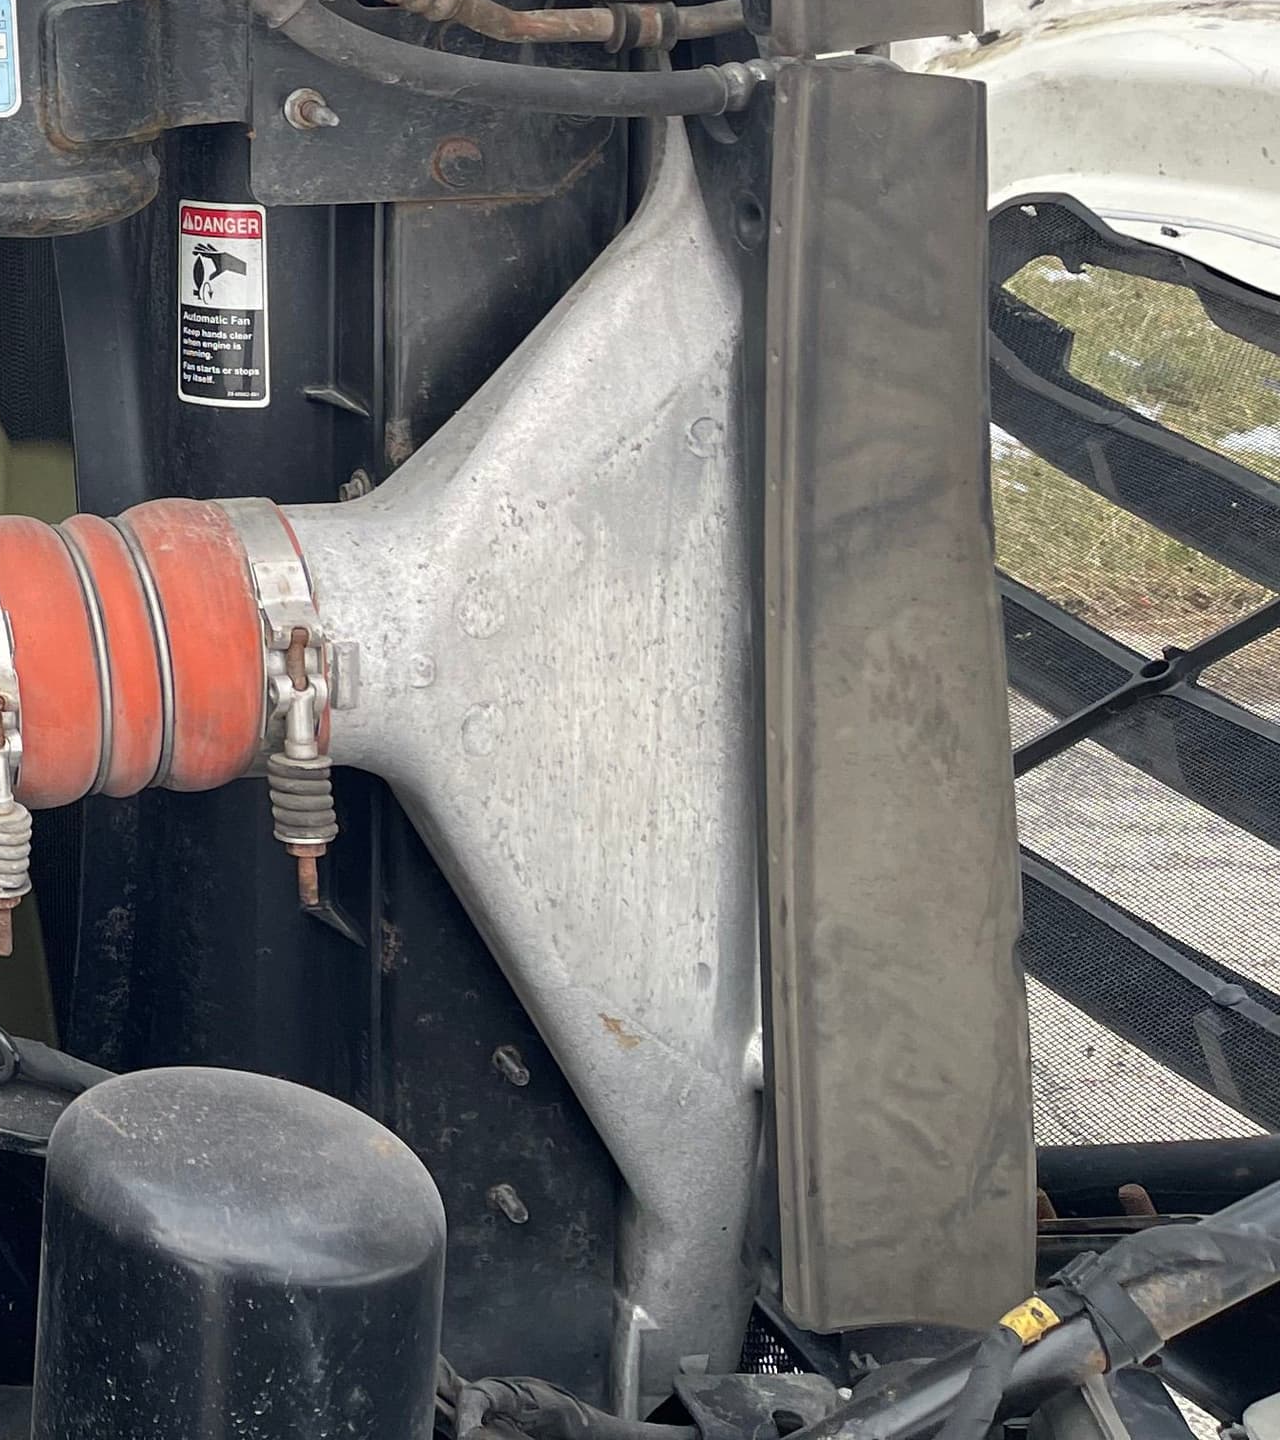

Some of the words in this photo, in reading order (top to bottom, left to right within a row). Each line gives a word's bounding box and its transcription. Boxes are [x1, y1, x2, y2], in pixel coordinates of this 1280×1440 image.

[193, 216, 259, 235] DANGER
[183, 311, 228, 324] Automatic
[230, 315, 251, 326] Fan
[183, 326, 200, 337] Keep
[201, 329, 227, 339] hands
[229, 331, 253, 340] clear
[183, 338, 201, 347] when
[202, 340, 231, 351] engine
[233, 342, 242, 350] is
[183, 348, 213, 360] running.
[183, 361, 195, 371] Fan
[196, 364, 220, 374] starts
[234, 367, 260, 376] stops
[183, 372, 191, 383] by
[192, 373, 215, 384] itself.
